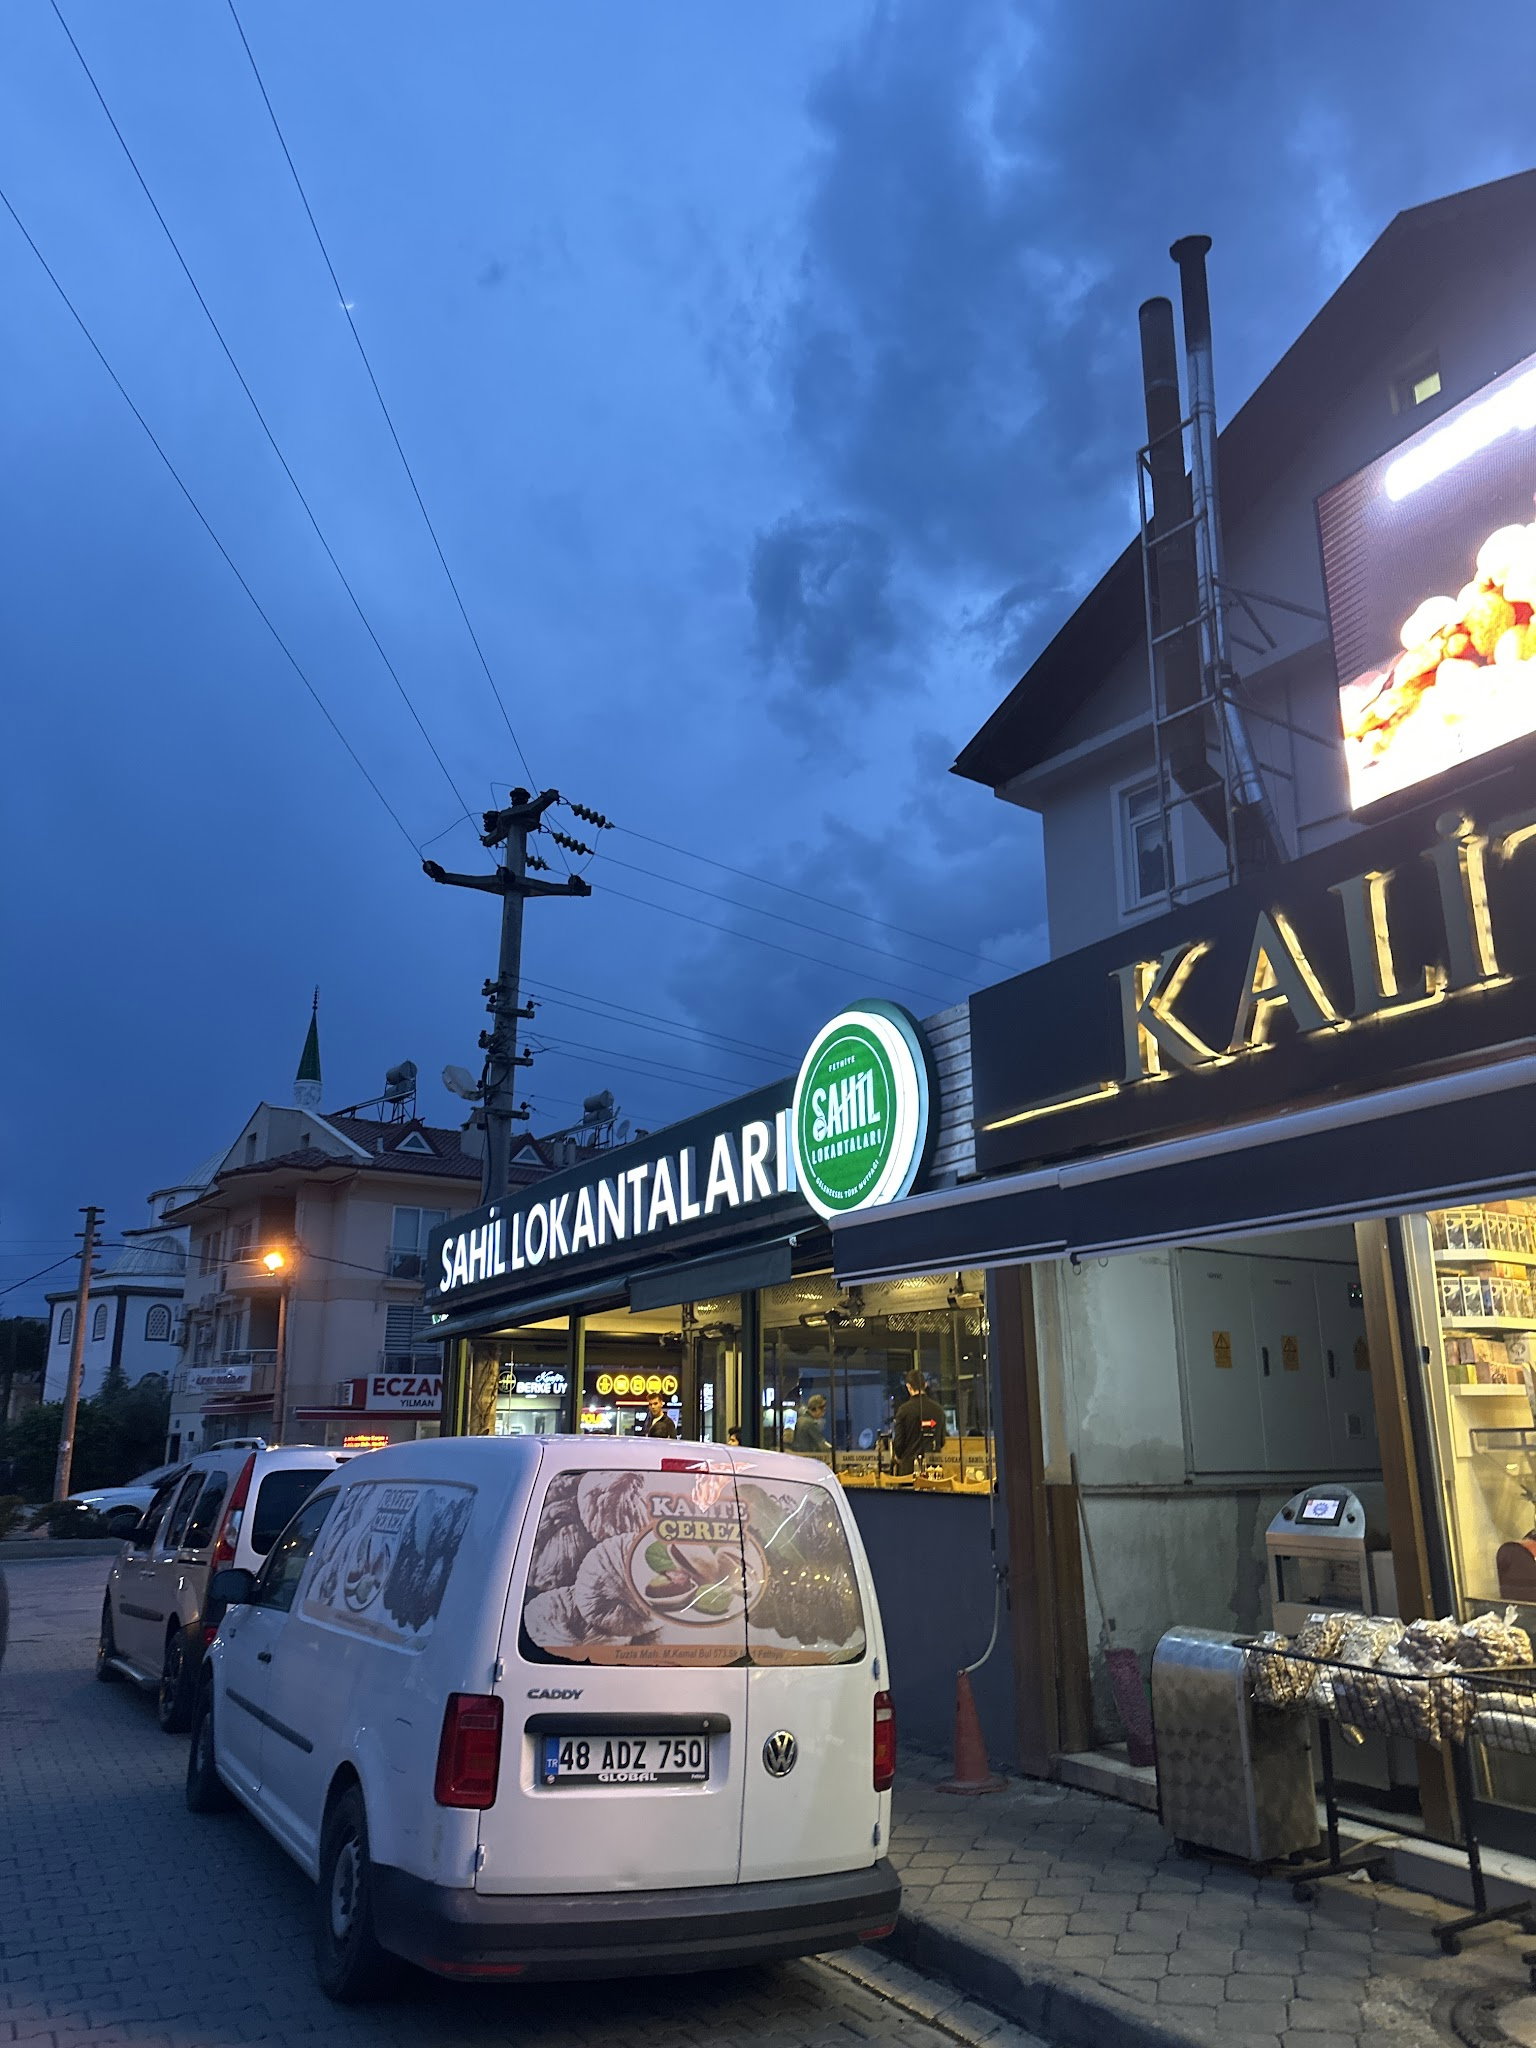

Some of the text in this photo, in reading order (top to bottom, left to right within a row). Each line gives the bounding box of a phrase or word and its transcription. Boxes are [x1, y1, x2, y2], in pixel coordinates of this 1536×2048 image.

[1108, 810, 1536, 1084] KALİ
[812, 1068, 881, 1142] SAHİL
[812, 1128, 882, 1165] LOKANTALARI
[440, 1108, 796, 1293] SAHİL LOKANTALARI
[516, 1382, 551, 1394] BERKE
[658, 1519, 744, 1541] ÇEREZ
[527, 1688, 584, 1700] CADDY
[546, 1758, 559, 1768] TR
[560, 1740, 702, 1770] 48 ADZ 750
[597, 1771, 659, 1782] GLOBAL
